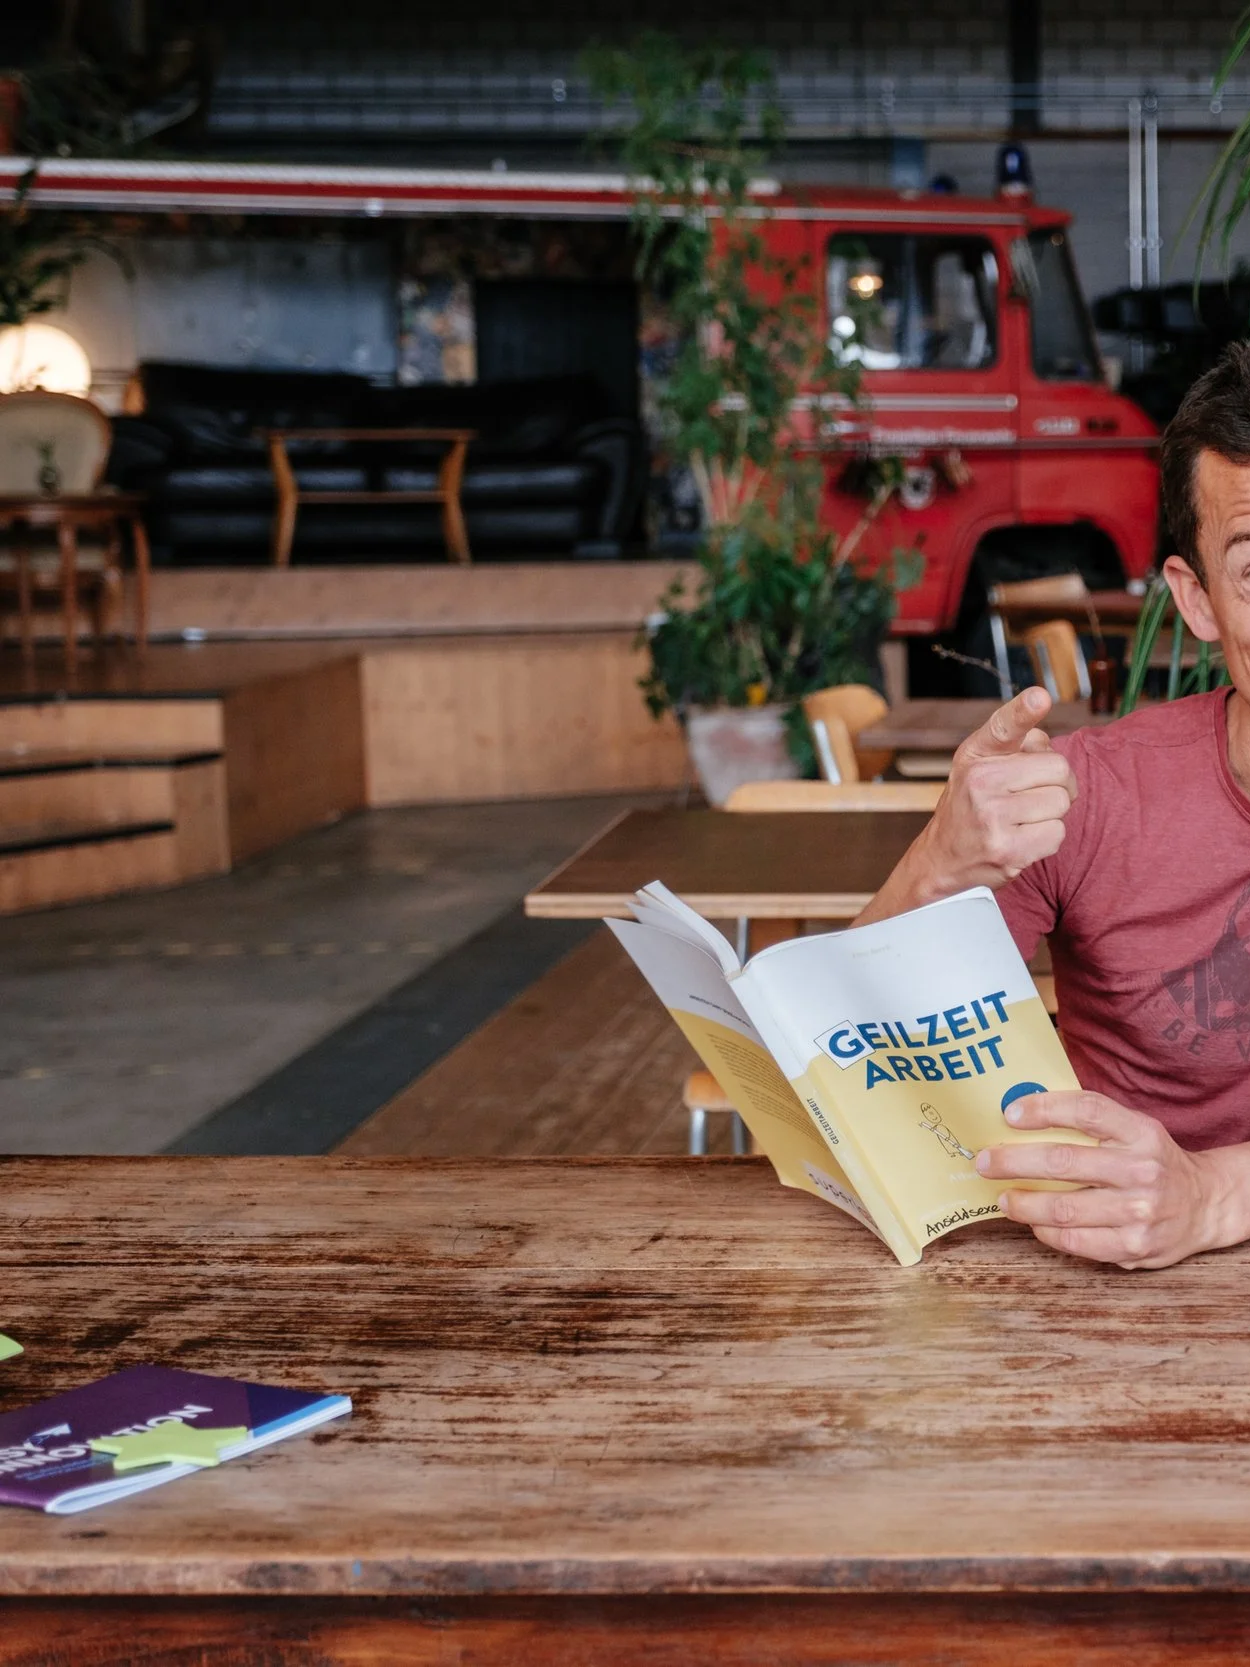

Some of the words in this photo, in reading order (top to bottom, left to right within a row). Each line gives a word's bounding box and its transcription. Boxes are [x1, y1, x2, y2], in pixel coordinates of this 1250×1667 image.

[828, 990, 1010, 1059] GEILZEIT
[1161, 1018, 1210, 1056] BE
[866, 1034, 1006, 1090] ARBEIT
[806, 1097, 840, 1145] GEILZEITARBEIT
